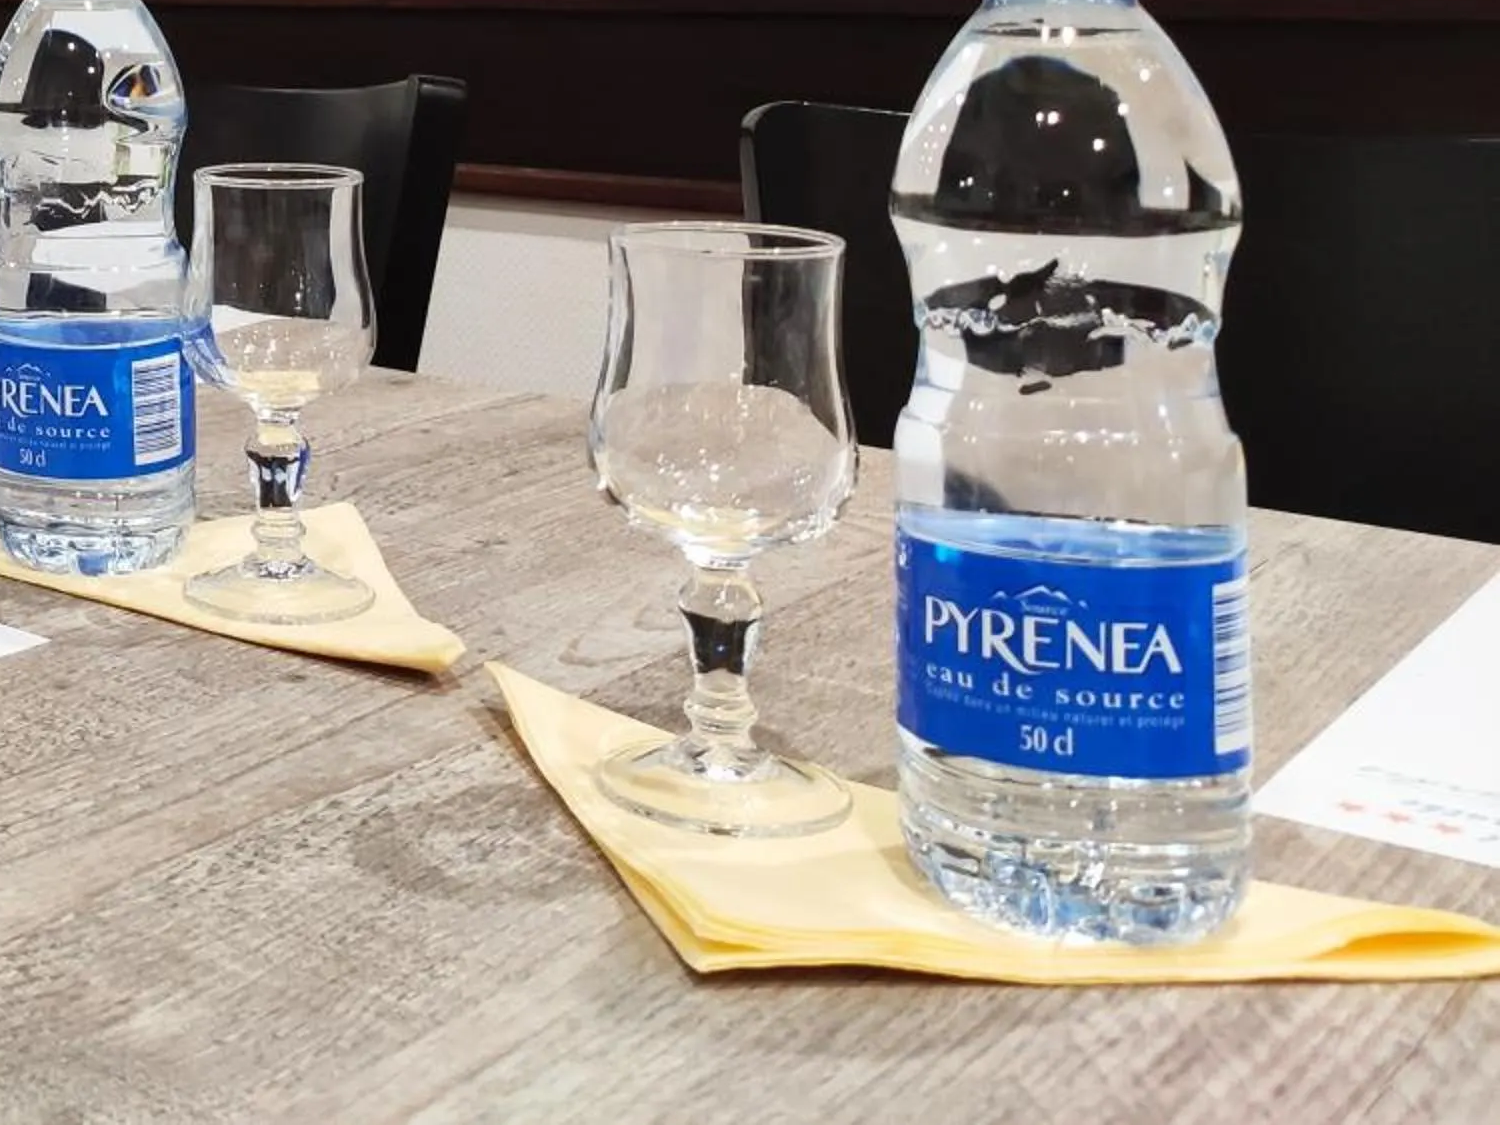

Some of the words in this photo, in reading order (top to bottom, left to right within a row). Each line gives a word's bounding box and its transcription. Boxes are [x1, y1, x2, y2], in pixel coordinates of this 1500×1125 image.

[7, 416, 26, 434] de
[35, 426, 111, 439] source
[924, 594, 1183, 675] PYRENEA
[925, 662, 974, 690] eau
[992, 672, 1034, 700] de
[1055, 687, 1185, 710] source
[1019, 723, 1049, 753] 50
[1053, 725, 1074, 756] cl
